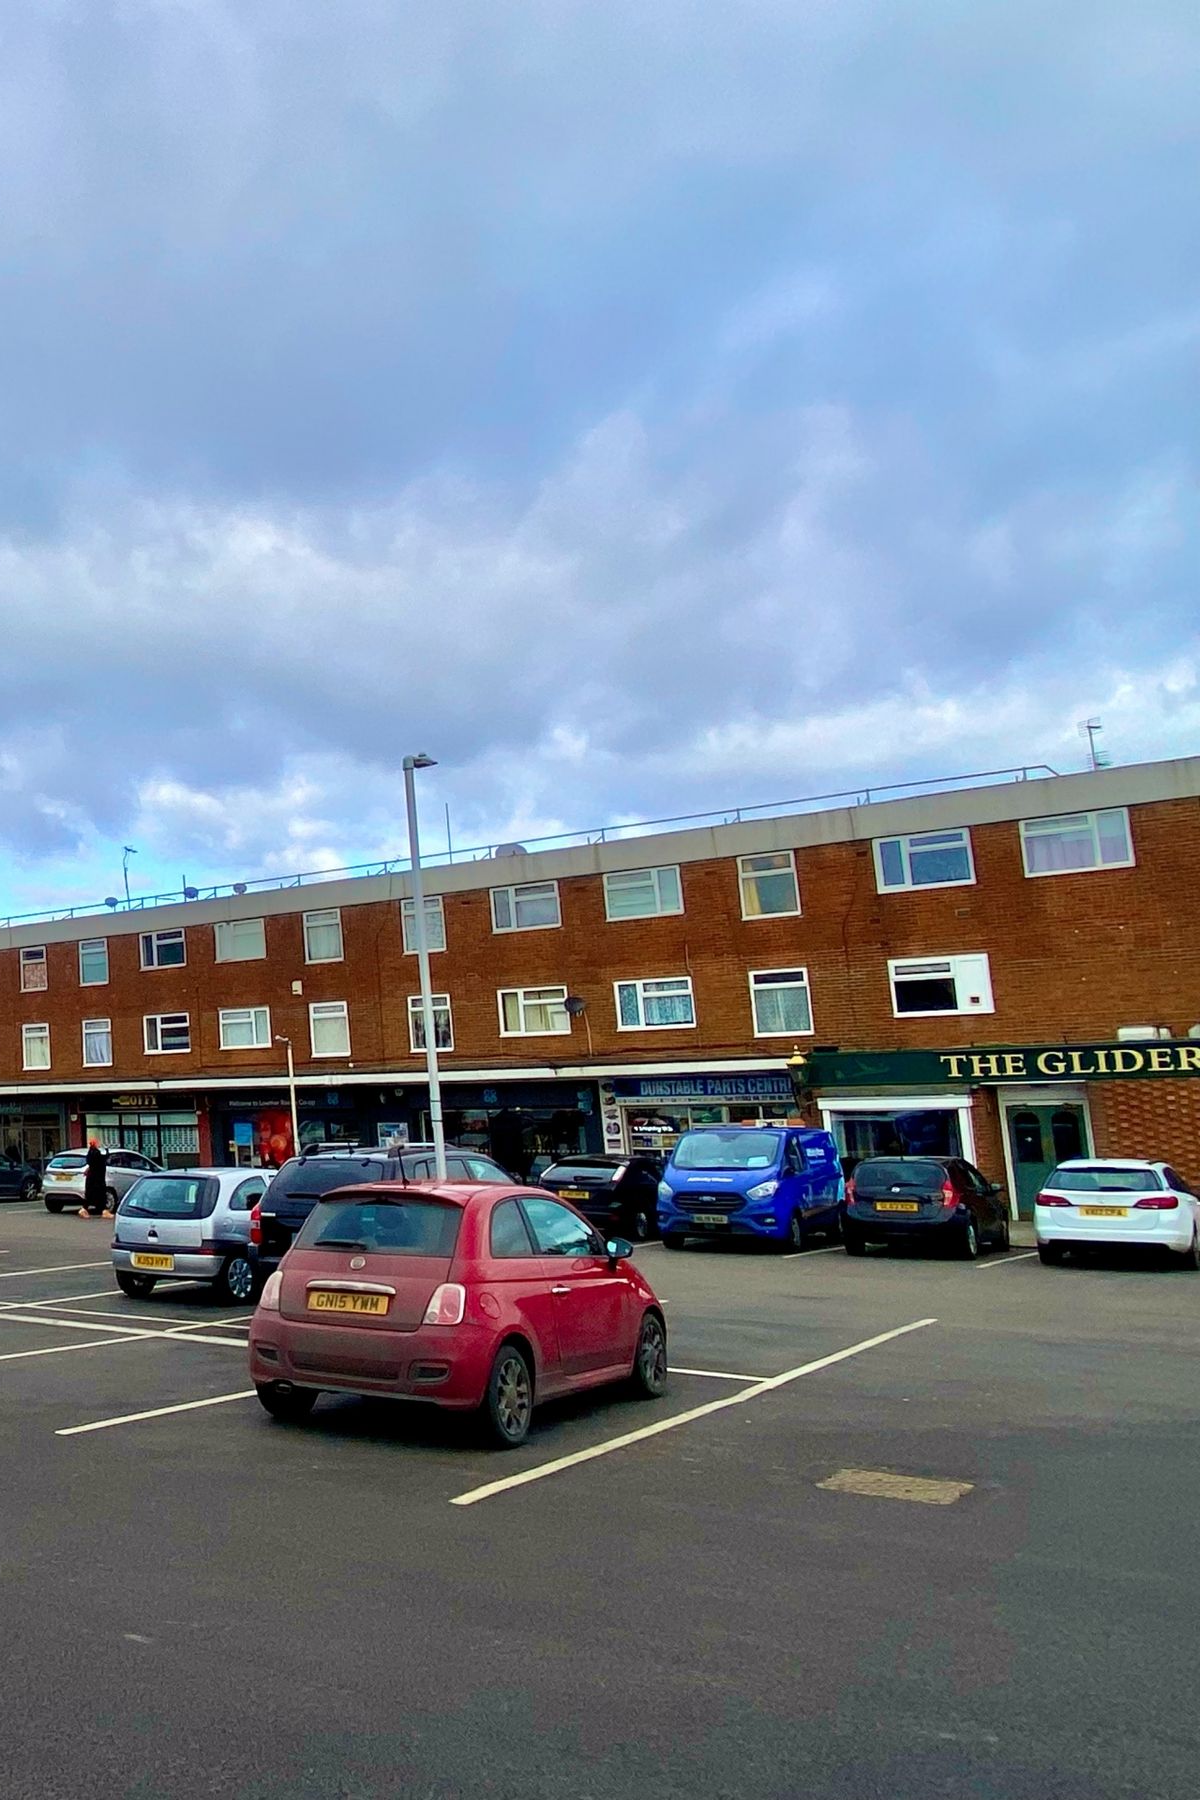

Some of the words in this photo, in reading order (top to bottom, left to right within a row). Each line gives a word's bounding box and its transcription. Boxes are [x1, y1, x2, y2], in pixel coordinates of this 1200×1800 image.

[940, 1053, 1027, 1077] THE
[1036, 1047, 1200, 1075] GLIDER
[640, 1080, 704, 1096] DUNSTABLE
[707, 1078, 746, 1094] PARTS
[316, 1294, 347, 1308] GN15
[351, 1295, 380, 1311] YWM
